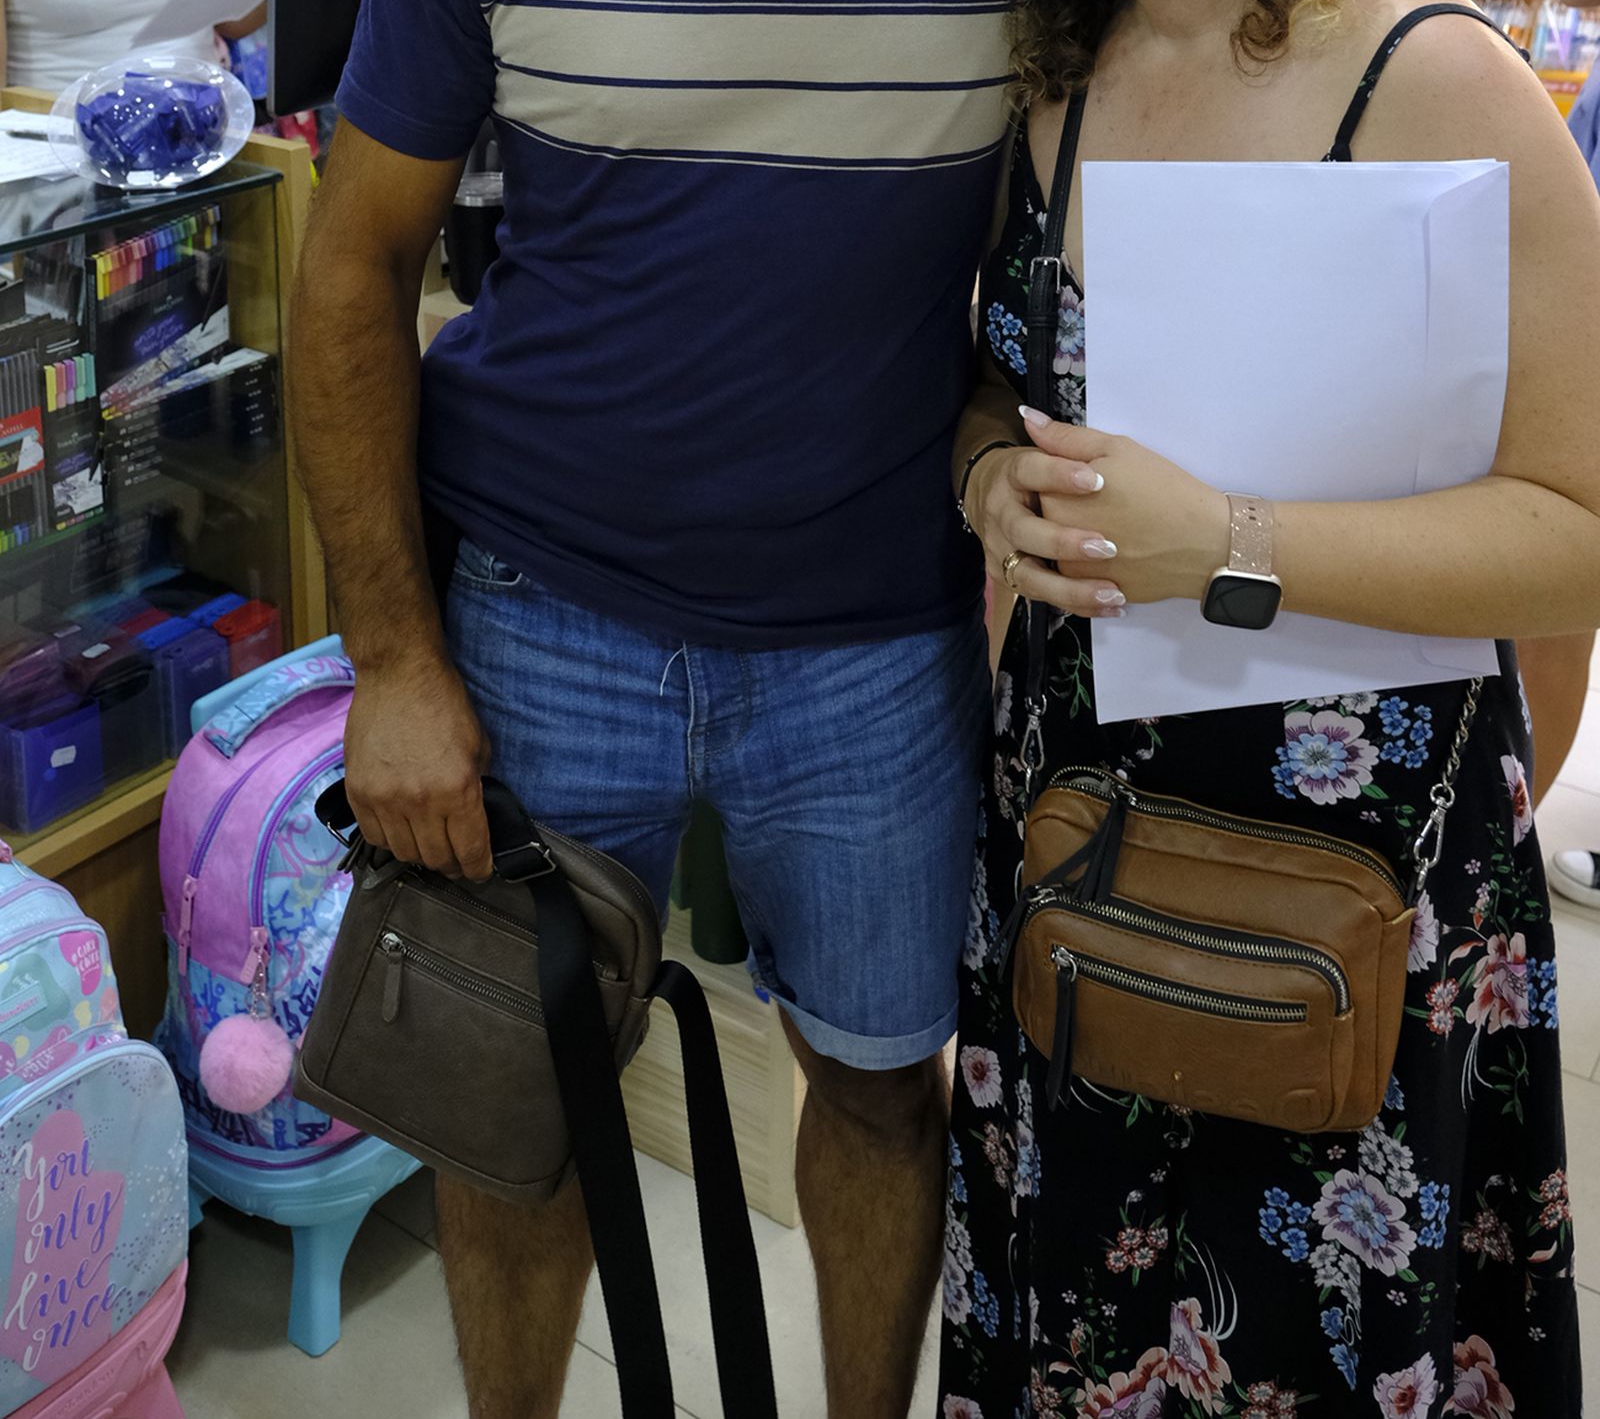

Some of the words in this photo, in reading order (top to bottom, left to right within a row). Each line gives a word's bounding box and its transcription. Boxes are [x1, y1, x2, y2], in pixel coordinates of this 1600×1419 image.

[24, 1182, 123, 1264] only
[4, 1253, 114, 1331] live
[22, 1282, 127, 1371] once
